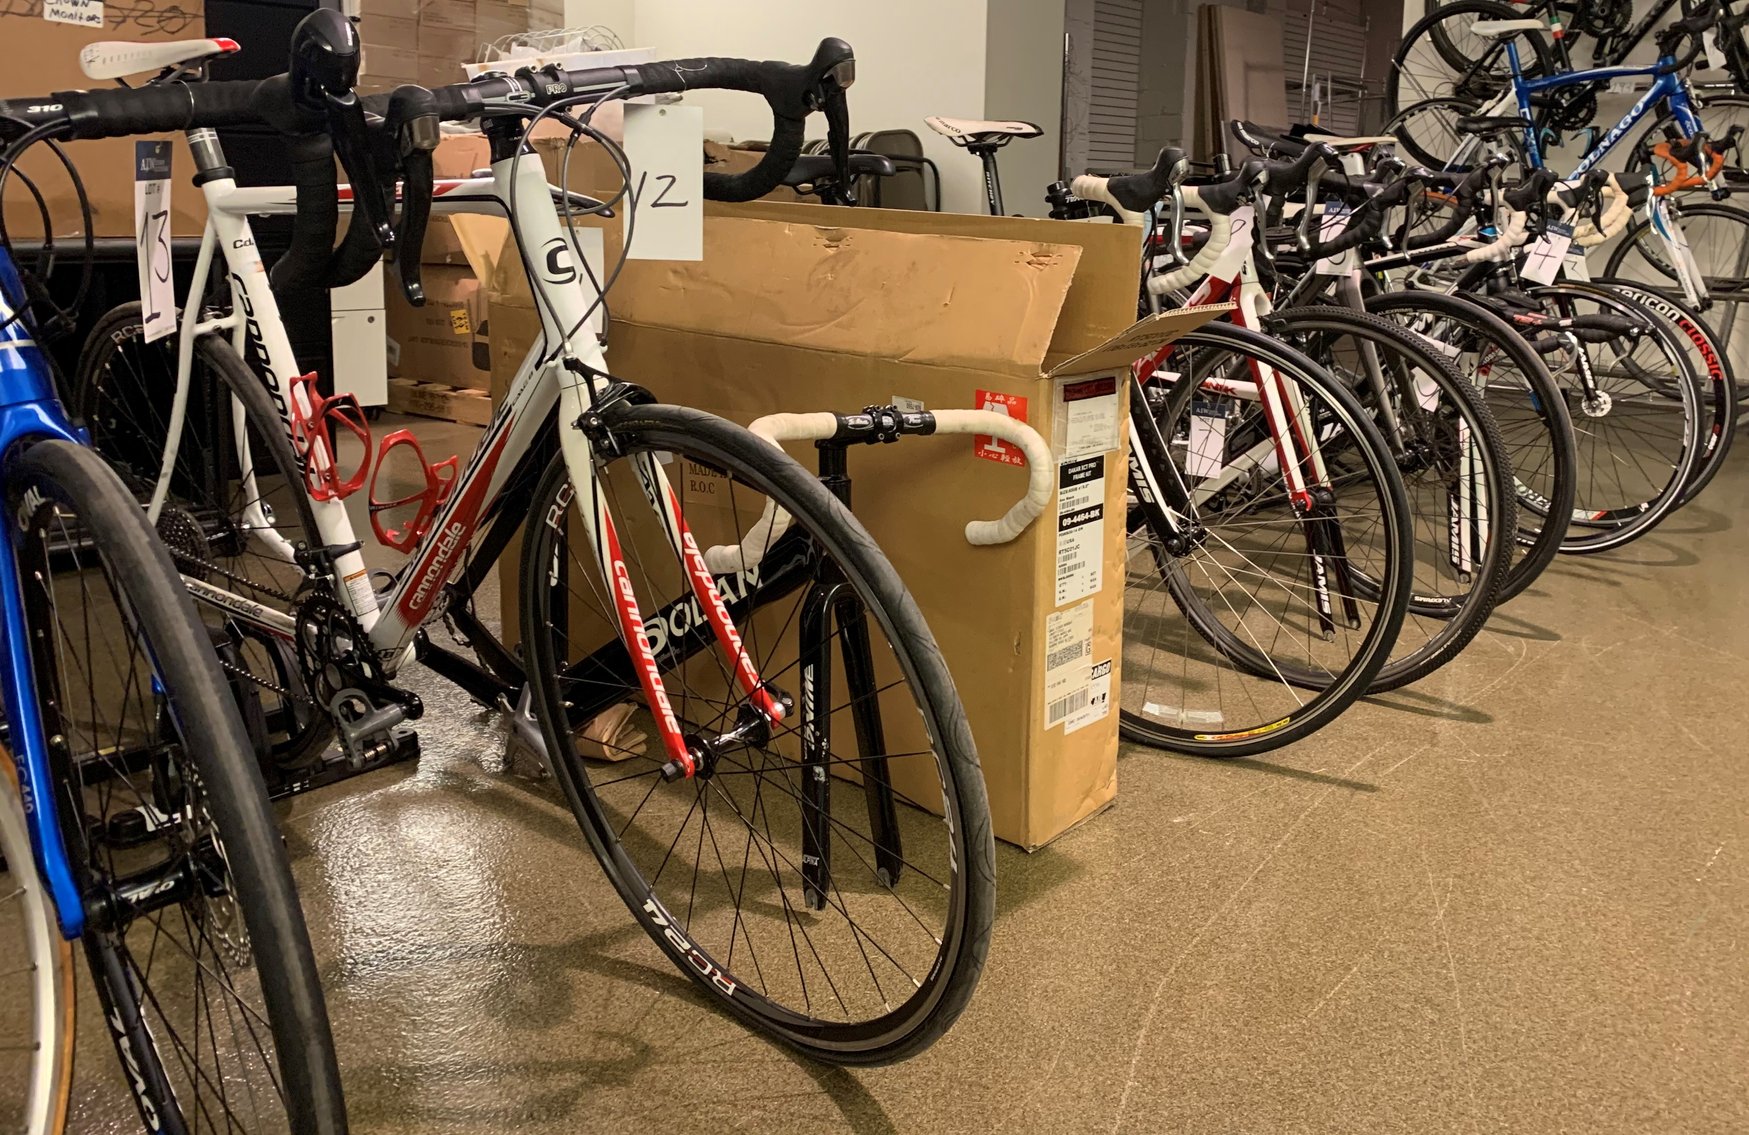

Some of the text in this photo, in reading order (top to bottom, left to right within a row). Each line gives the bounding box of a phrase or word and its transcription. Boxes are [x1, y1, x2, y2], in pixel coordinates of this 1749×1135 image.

[26, 103, 63, 113] 310
[546, 83, 567, 95] PRO
[633, 170, 688, 216] 12
[139, 210, 171, 324] 13
[1533, 239, 1558, 270] 4
[1678, 319, 1724, 381] classic
[977, 449, 1023, 466] 小心輕放
[408, 521, 467, 610] cannondale
[1313, 549, 1332, 615] JAMIS
[683, 531, 764, 689] cannondale
[614, 560, 681, 734] cannondale
[643, 898, 737, 996] RC24
